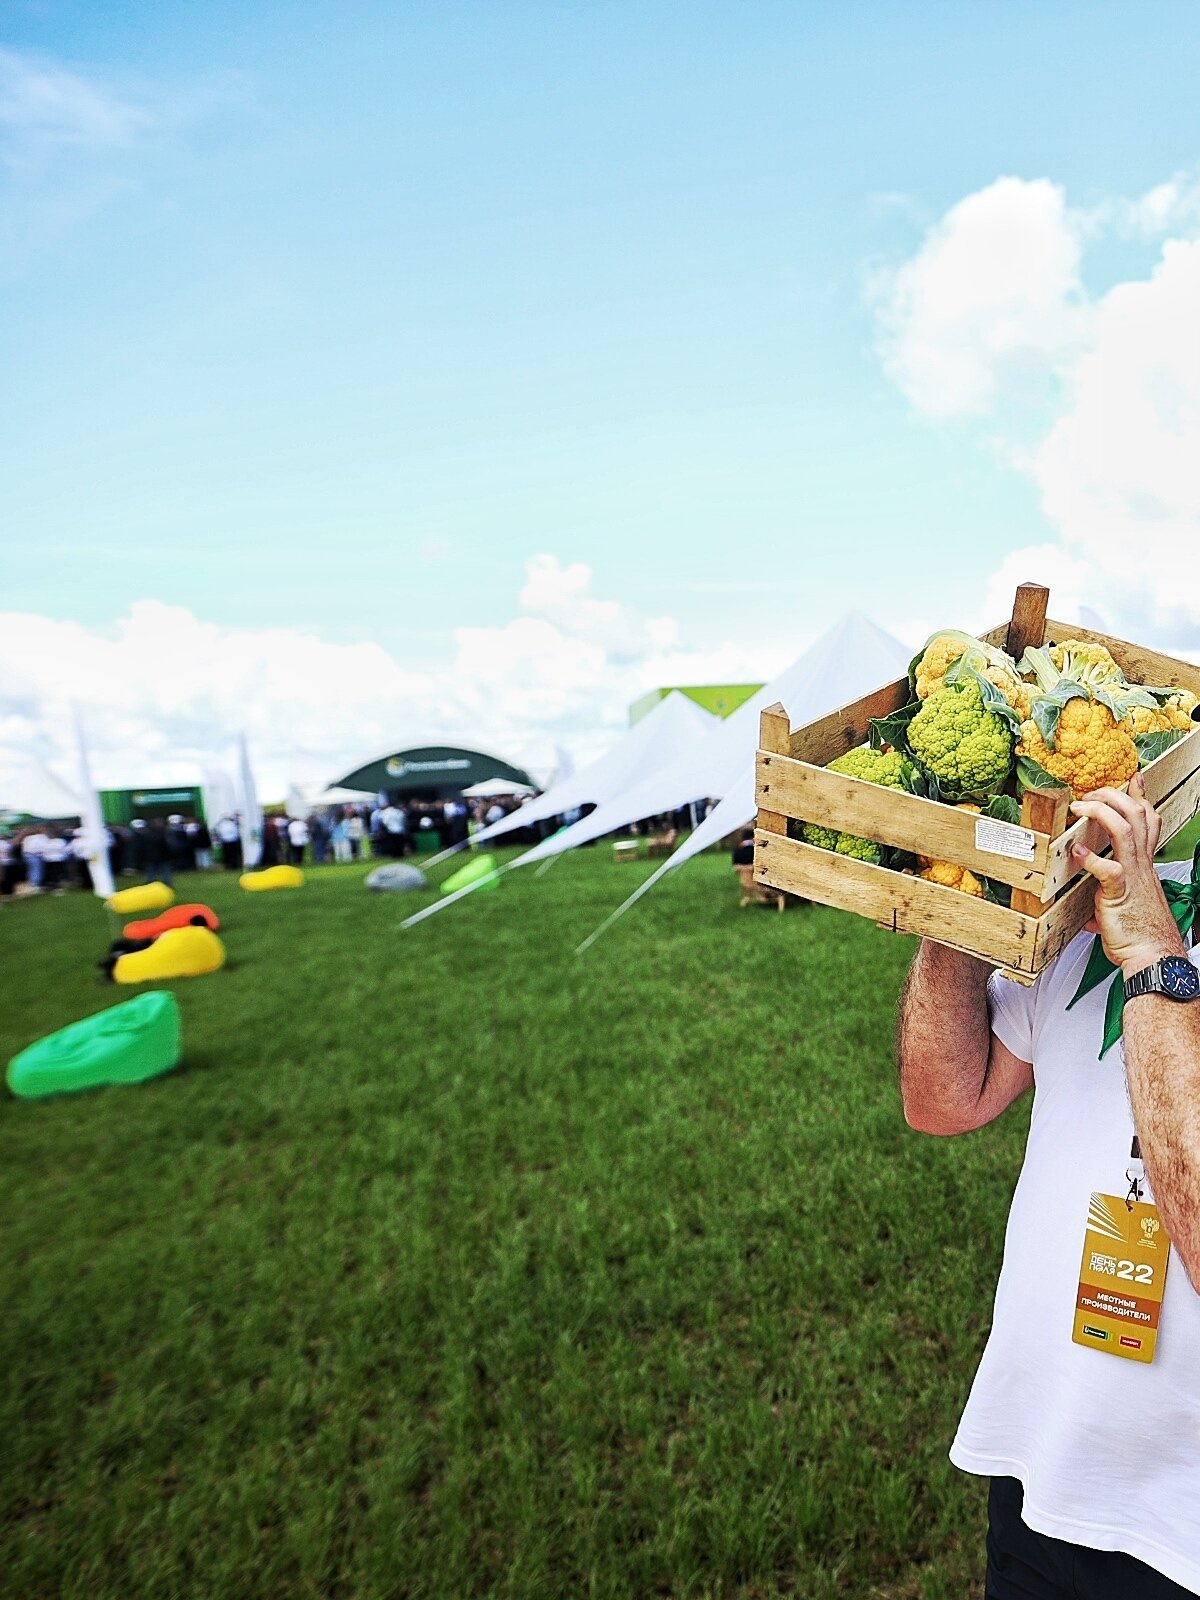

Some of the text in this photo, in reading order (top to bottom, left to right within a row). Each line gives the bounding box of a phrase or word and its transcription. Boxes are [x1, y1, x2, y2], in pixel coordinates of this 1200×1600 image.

[1090, 1255, 1116, 1268] ДЕНЬ
[1116, 1260, 1154, 1285] 22
[1081, 1297, 1151, 1321] ПРОИЗВОДИТЕЛИ
[1096, 1292, 1137, 1309] МЕСТНЫЕ
